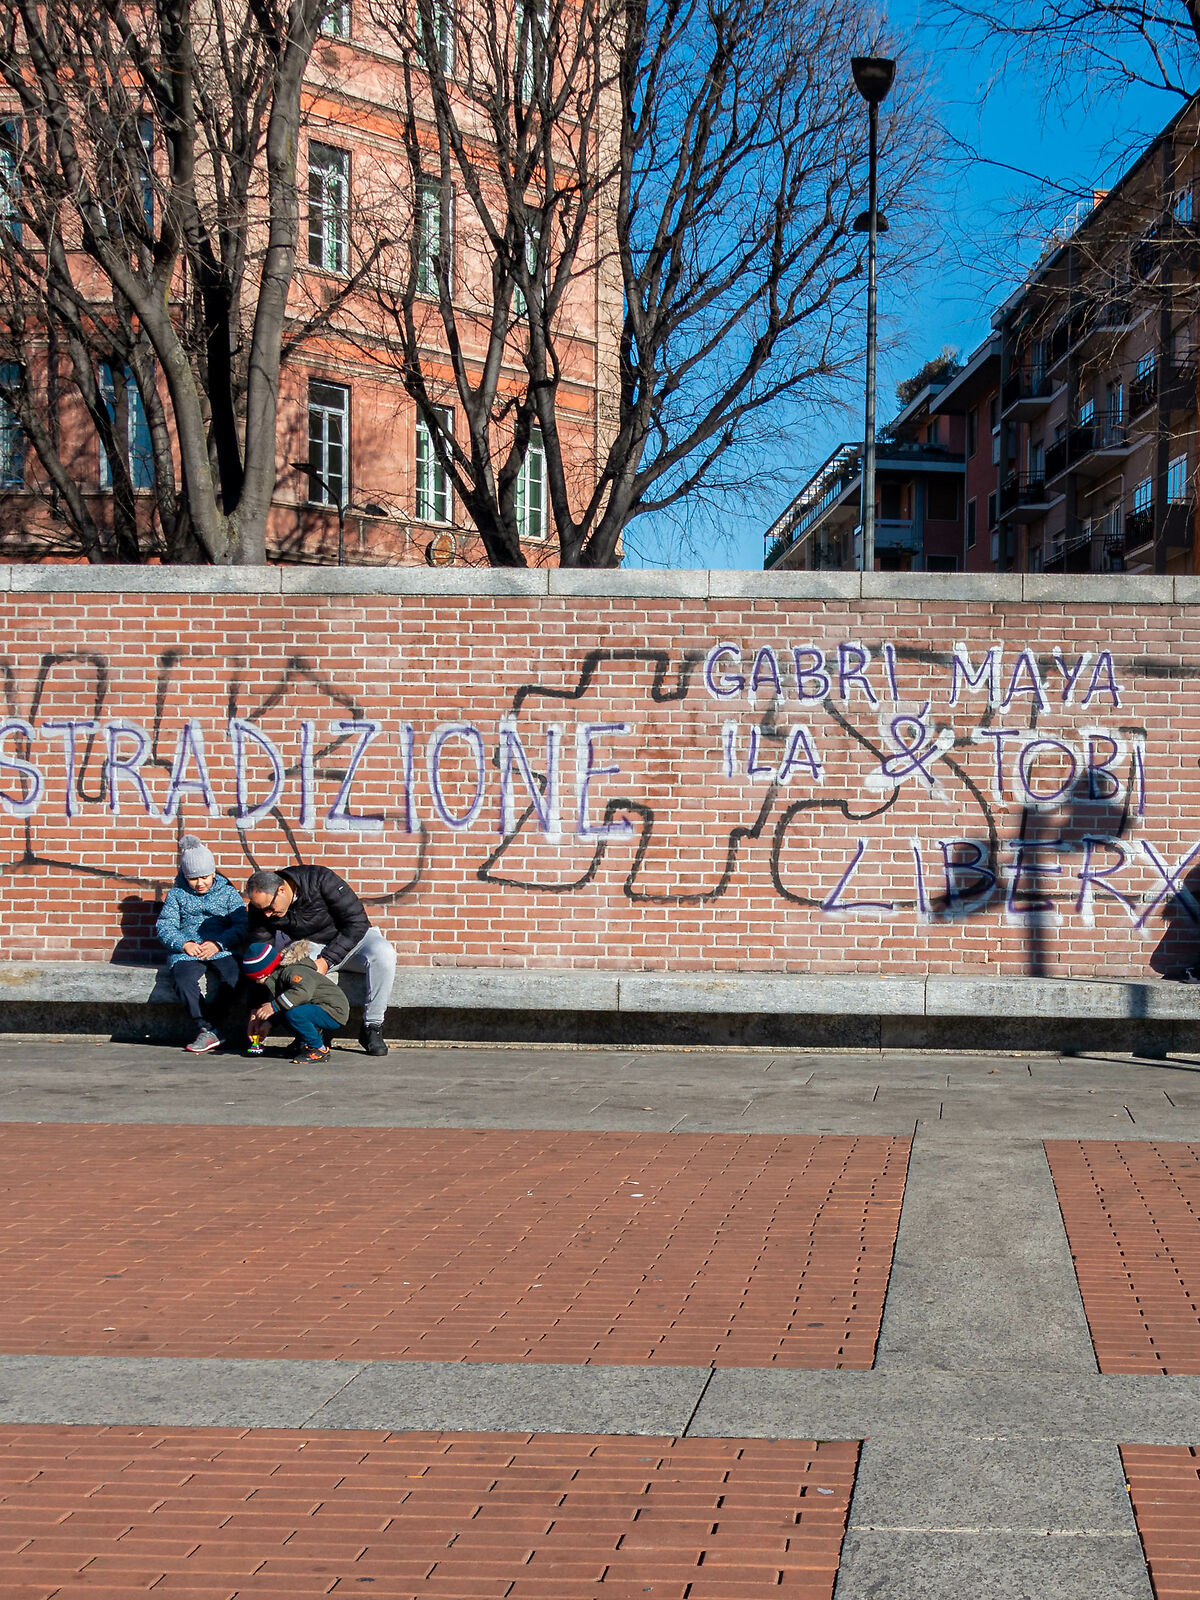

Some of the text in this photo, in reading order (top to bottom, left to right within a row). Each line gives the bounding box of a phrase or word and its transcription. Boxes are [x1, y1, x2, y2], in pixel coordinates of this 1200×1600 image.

[703, 640, 1124, 713] GABRI MAYA
[0, 716, 634, 838] STRADIZIONE
[722, 700, 1147, 818] ILA & TOBI
